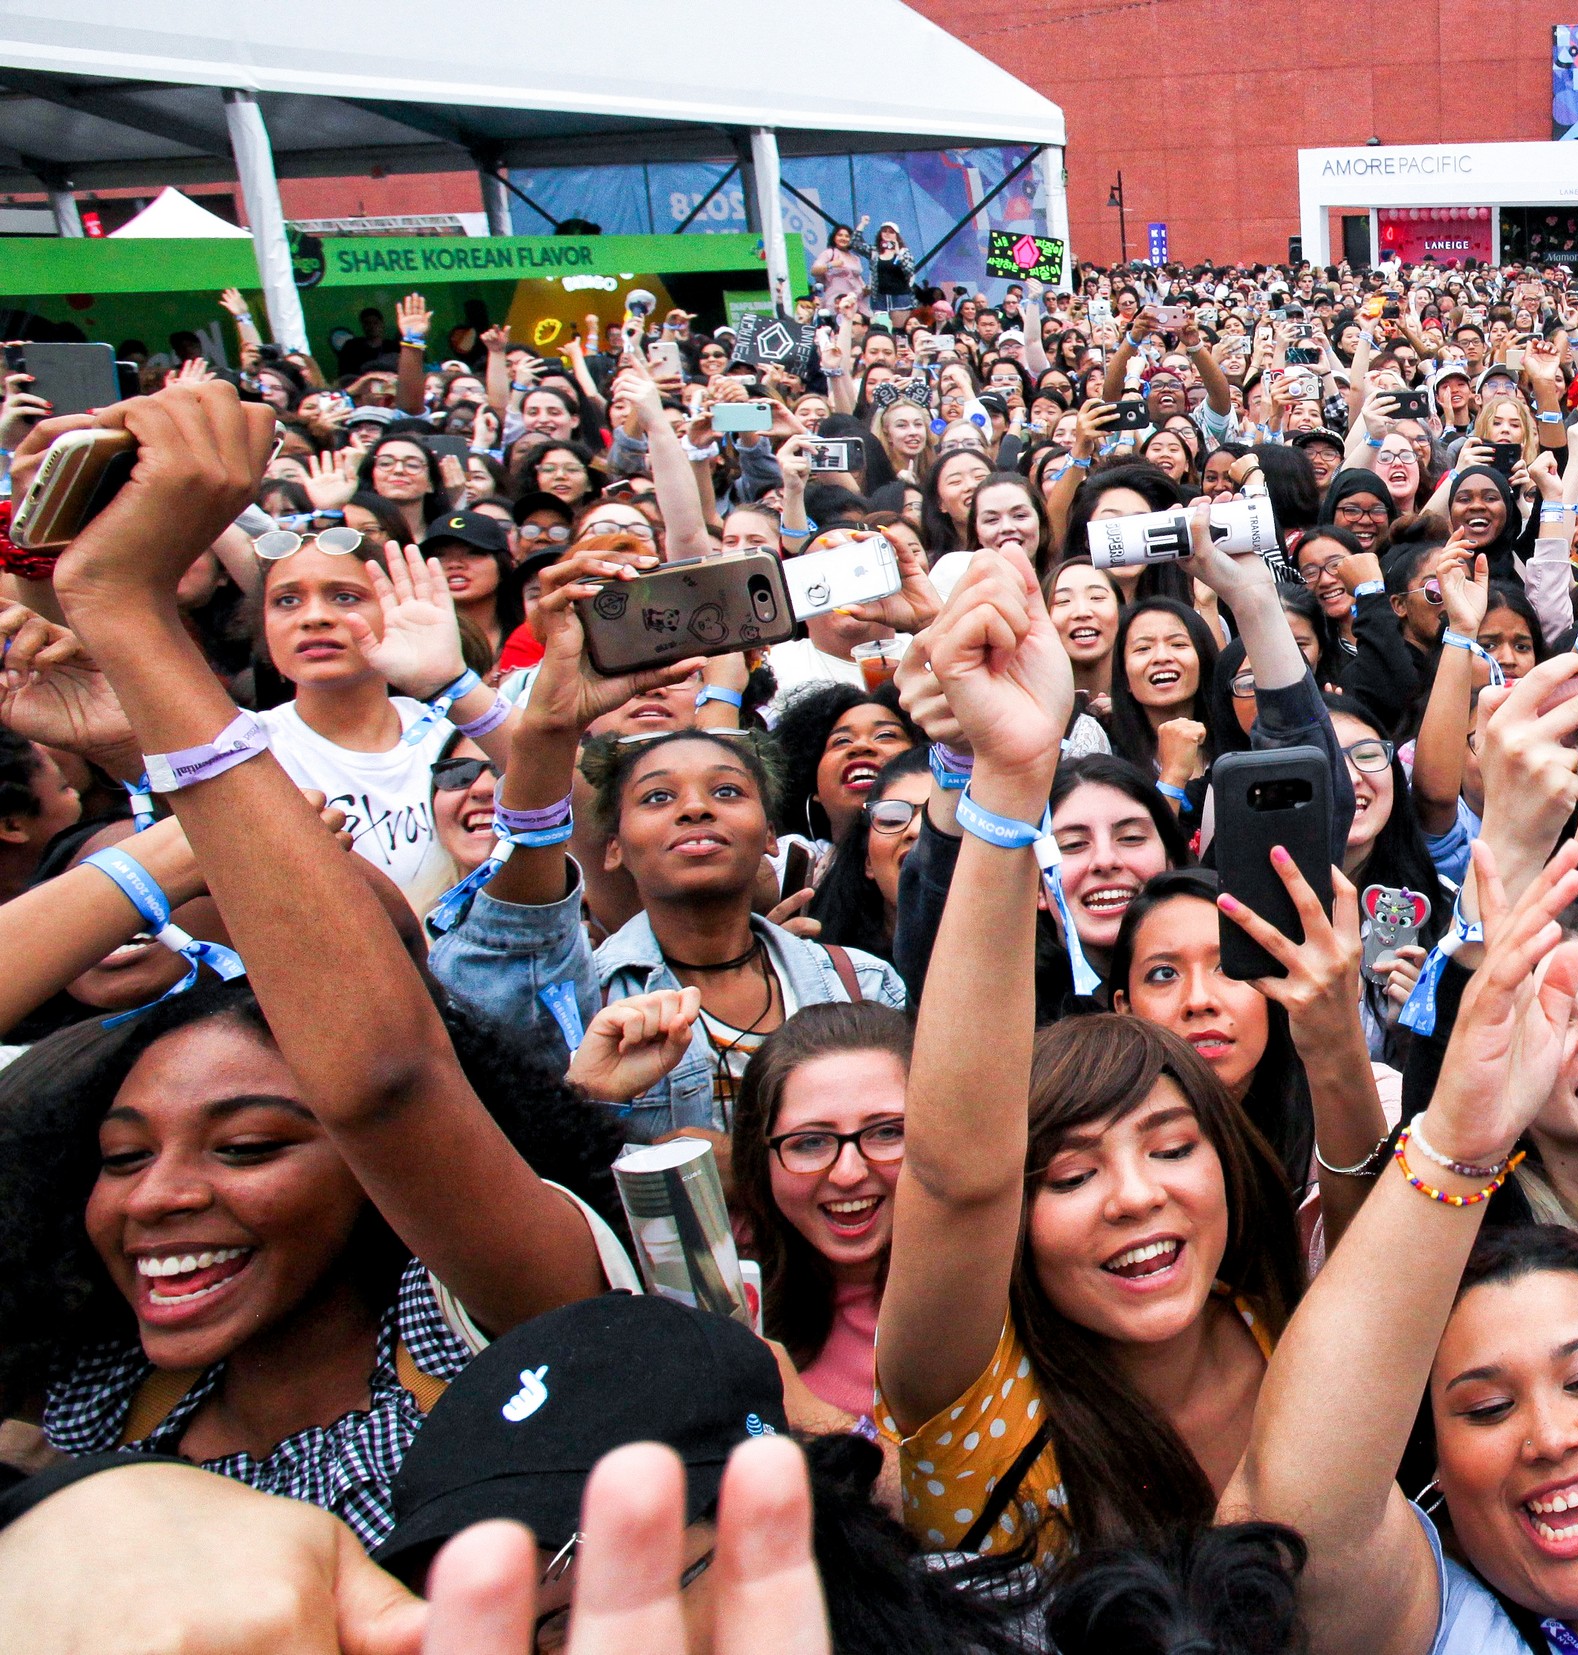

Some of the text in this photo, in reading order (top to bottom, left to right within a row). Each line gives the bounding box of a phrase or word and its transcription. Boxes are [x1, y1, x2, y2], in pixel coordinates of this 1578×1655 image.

[1321, 154, 1473, 177] AMOREPACIFIC
[1424, 239, 1470, 251] LANEIGE
[338, 248, 418, 274] SHARE
[422, 246, 514, 271] KOREAN
[516, 245, 594, 267] FLAVOR
[731, 313, 758, 362] PENTAGON
[1105, 522, 1125, 558] SUPER
[977, 818, 1020, 840] KCON!
[111, 859, 167, 924] KCON 2018 NY
[553, 1000, 578, 1040] GENERAL
[681, 1168, 703, 1183] CUBE
[1556, 1634, 1570, 1646] NY
